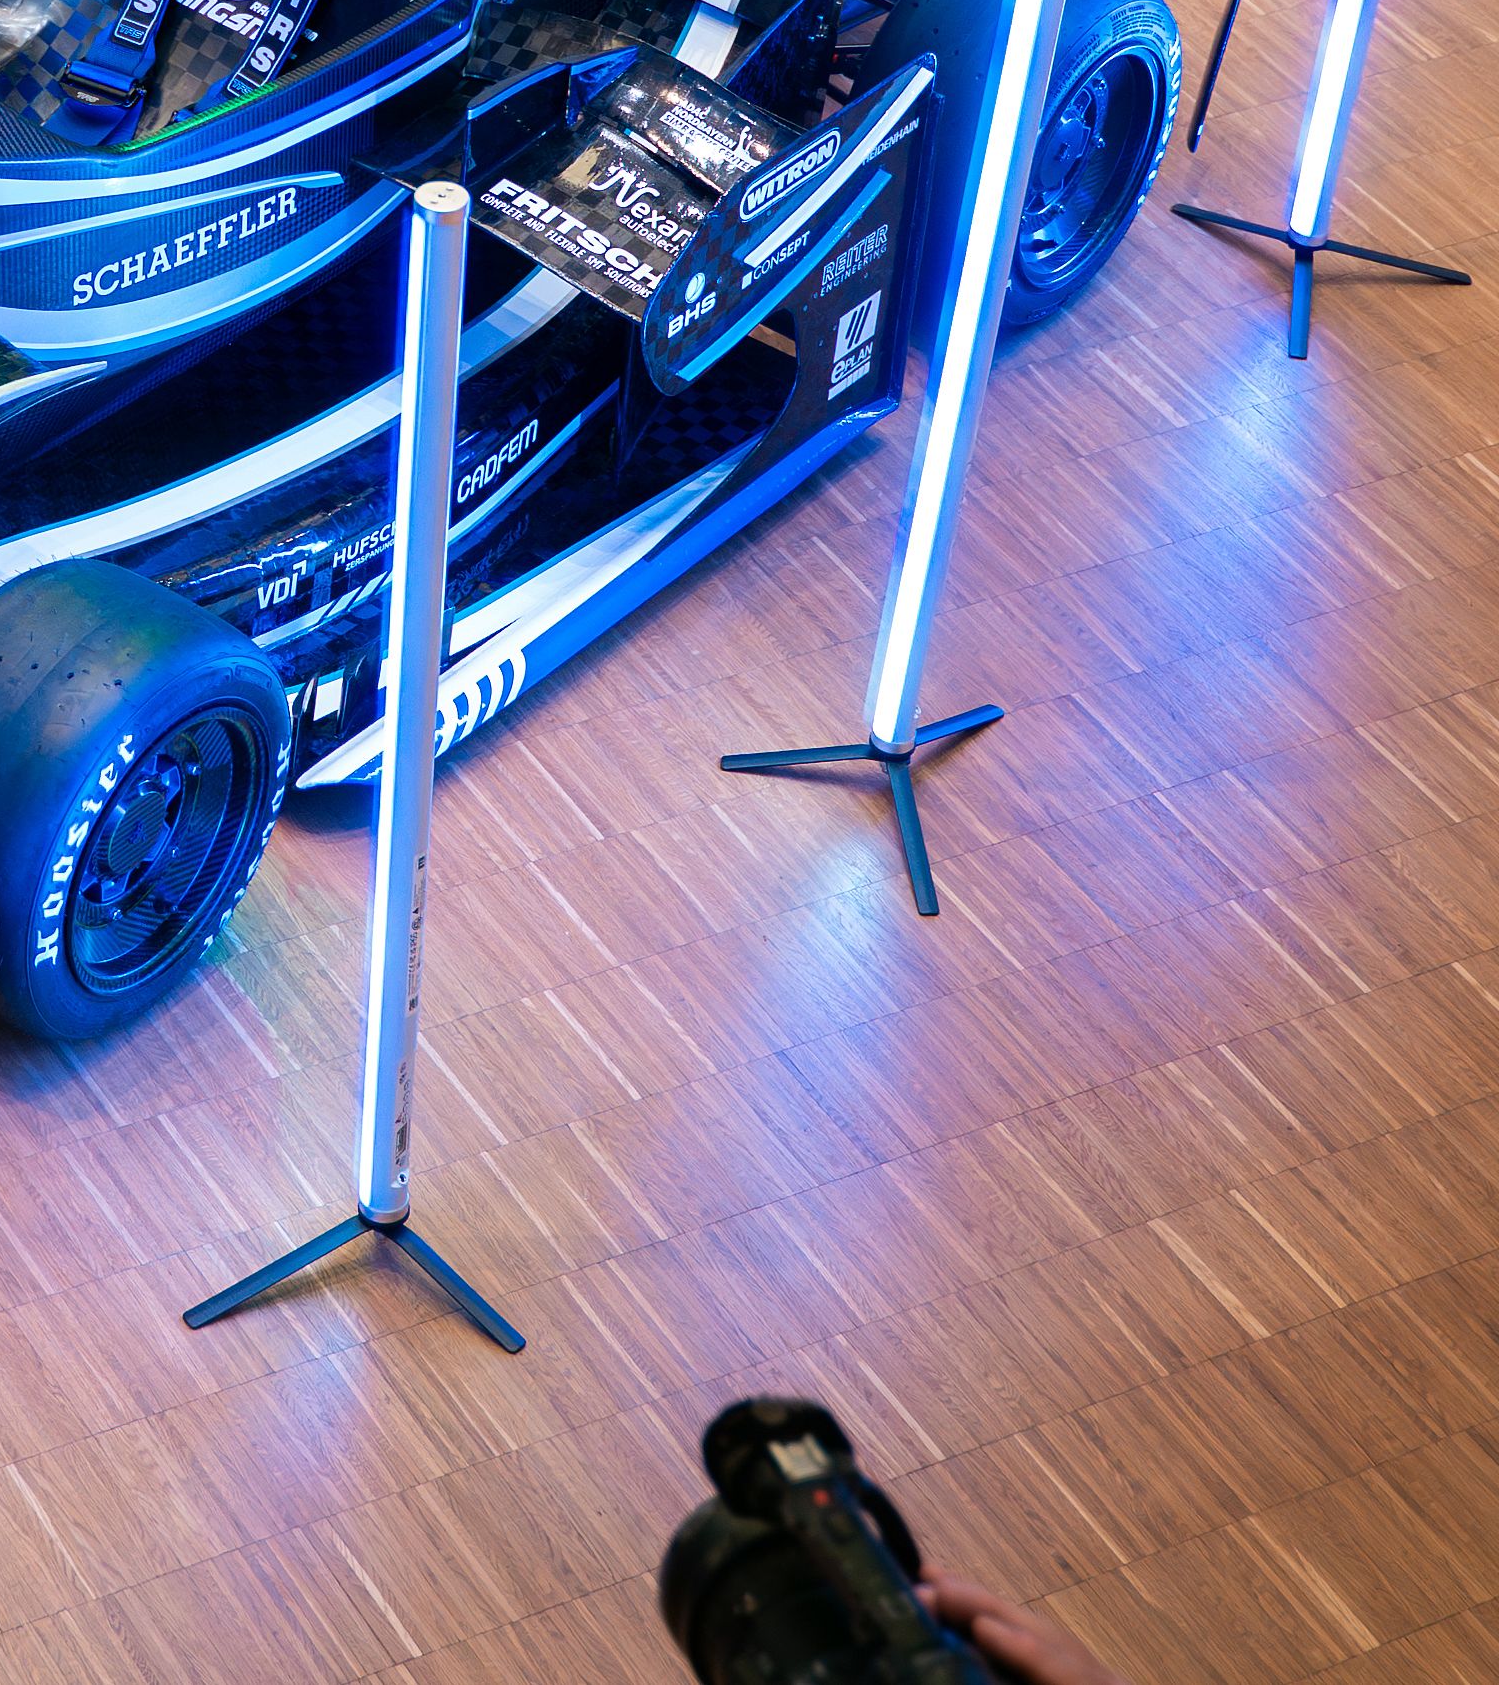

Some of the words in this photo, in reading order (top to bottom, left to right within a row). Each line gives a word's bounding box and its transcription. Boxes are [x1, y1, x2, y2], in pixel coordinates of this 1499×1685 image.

[119, 23, 145, 39] TRS
[671, 105, 737, 150] NORDBAYERN
[746, 138, 835, 210] WITRON
[488, 178, 664, 290] FRITSCH
[588, 165, 692, 247] Nexan
[73, 186, 297, 306] SCHAEFFLER
[480, 193, 522, 223] COMPLETE
[523, 215, 546, 233] AND
[545, 228, 588, 258] FLEXIBLE
[585, 254, 607, 272] SMT
[604, 266, 652, 298] SOLUTIONS
[753, 230, 810, 281] CONSEPT
[820, 246, 887, 297] ENGINEERING
[822, 224, 889, 286] REITER
[667, 291, 717, 339] BHS
[457, 419, 539, 504] CADFEM
[345, 538, 395, 571] ZERSPANUNG
[257, 571, 298, 610] VDI
